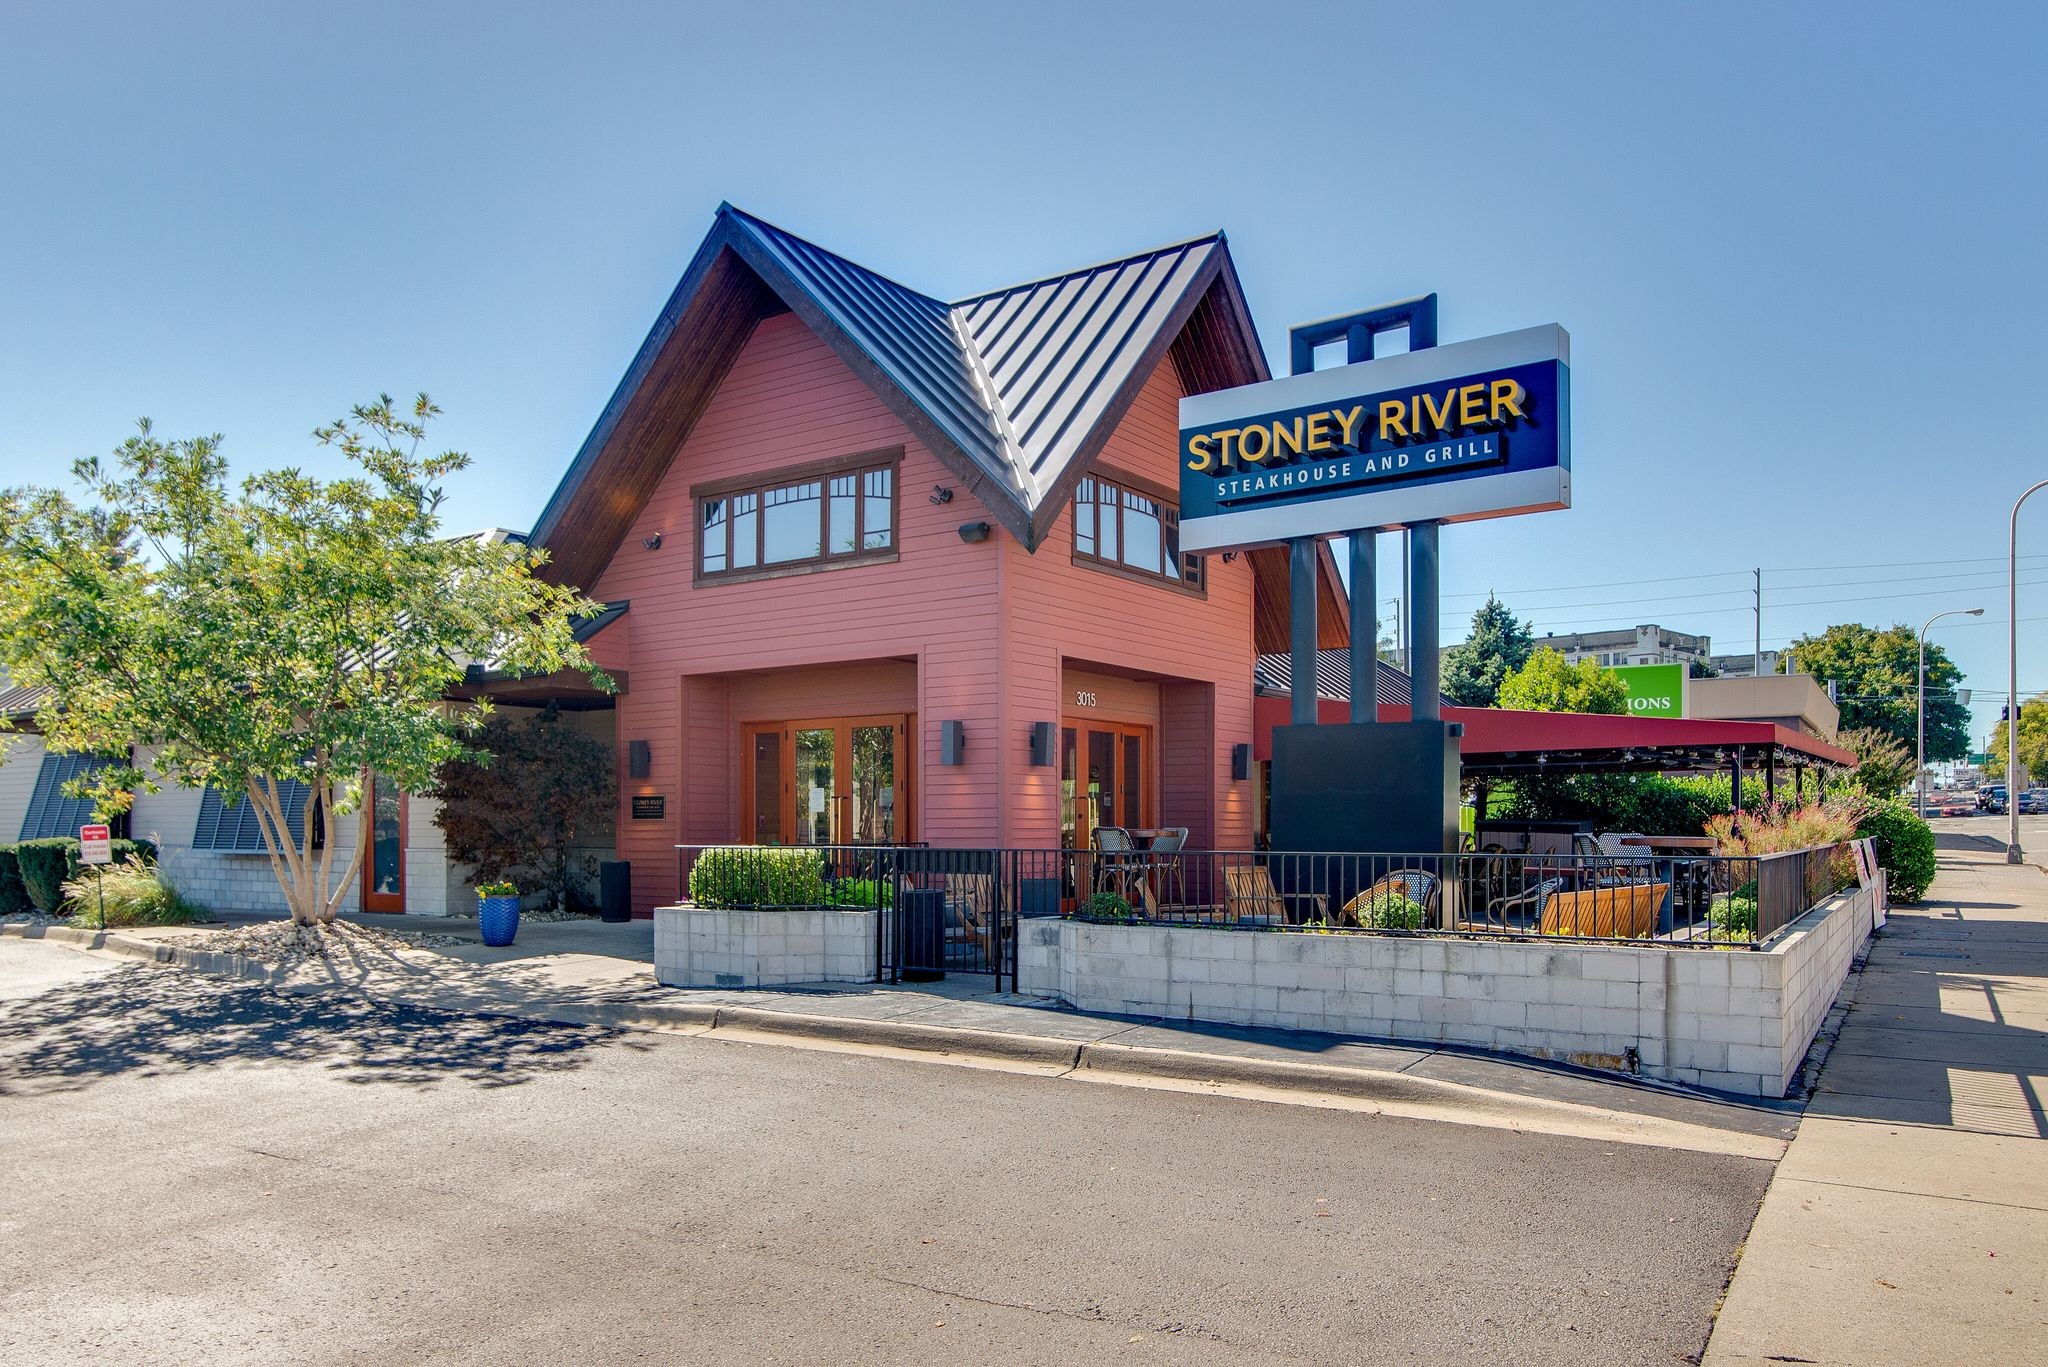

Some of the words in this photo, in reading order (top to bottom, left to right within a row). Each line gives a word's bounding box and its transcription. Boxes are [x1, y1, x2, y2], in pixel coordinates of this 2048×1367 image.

[1187, 405, 1366, 471] STONEY
[1379, 378, 1524, 440] RIVER
[1218, 463, 1352, 496] STEAKHOUSE
[1365, 453, 1410, 473] AND
[1425, 439, 1493, 463] GRILL
[1076, 691, 1096, 707] 3015
